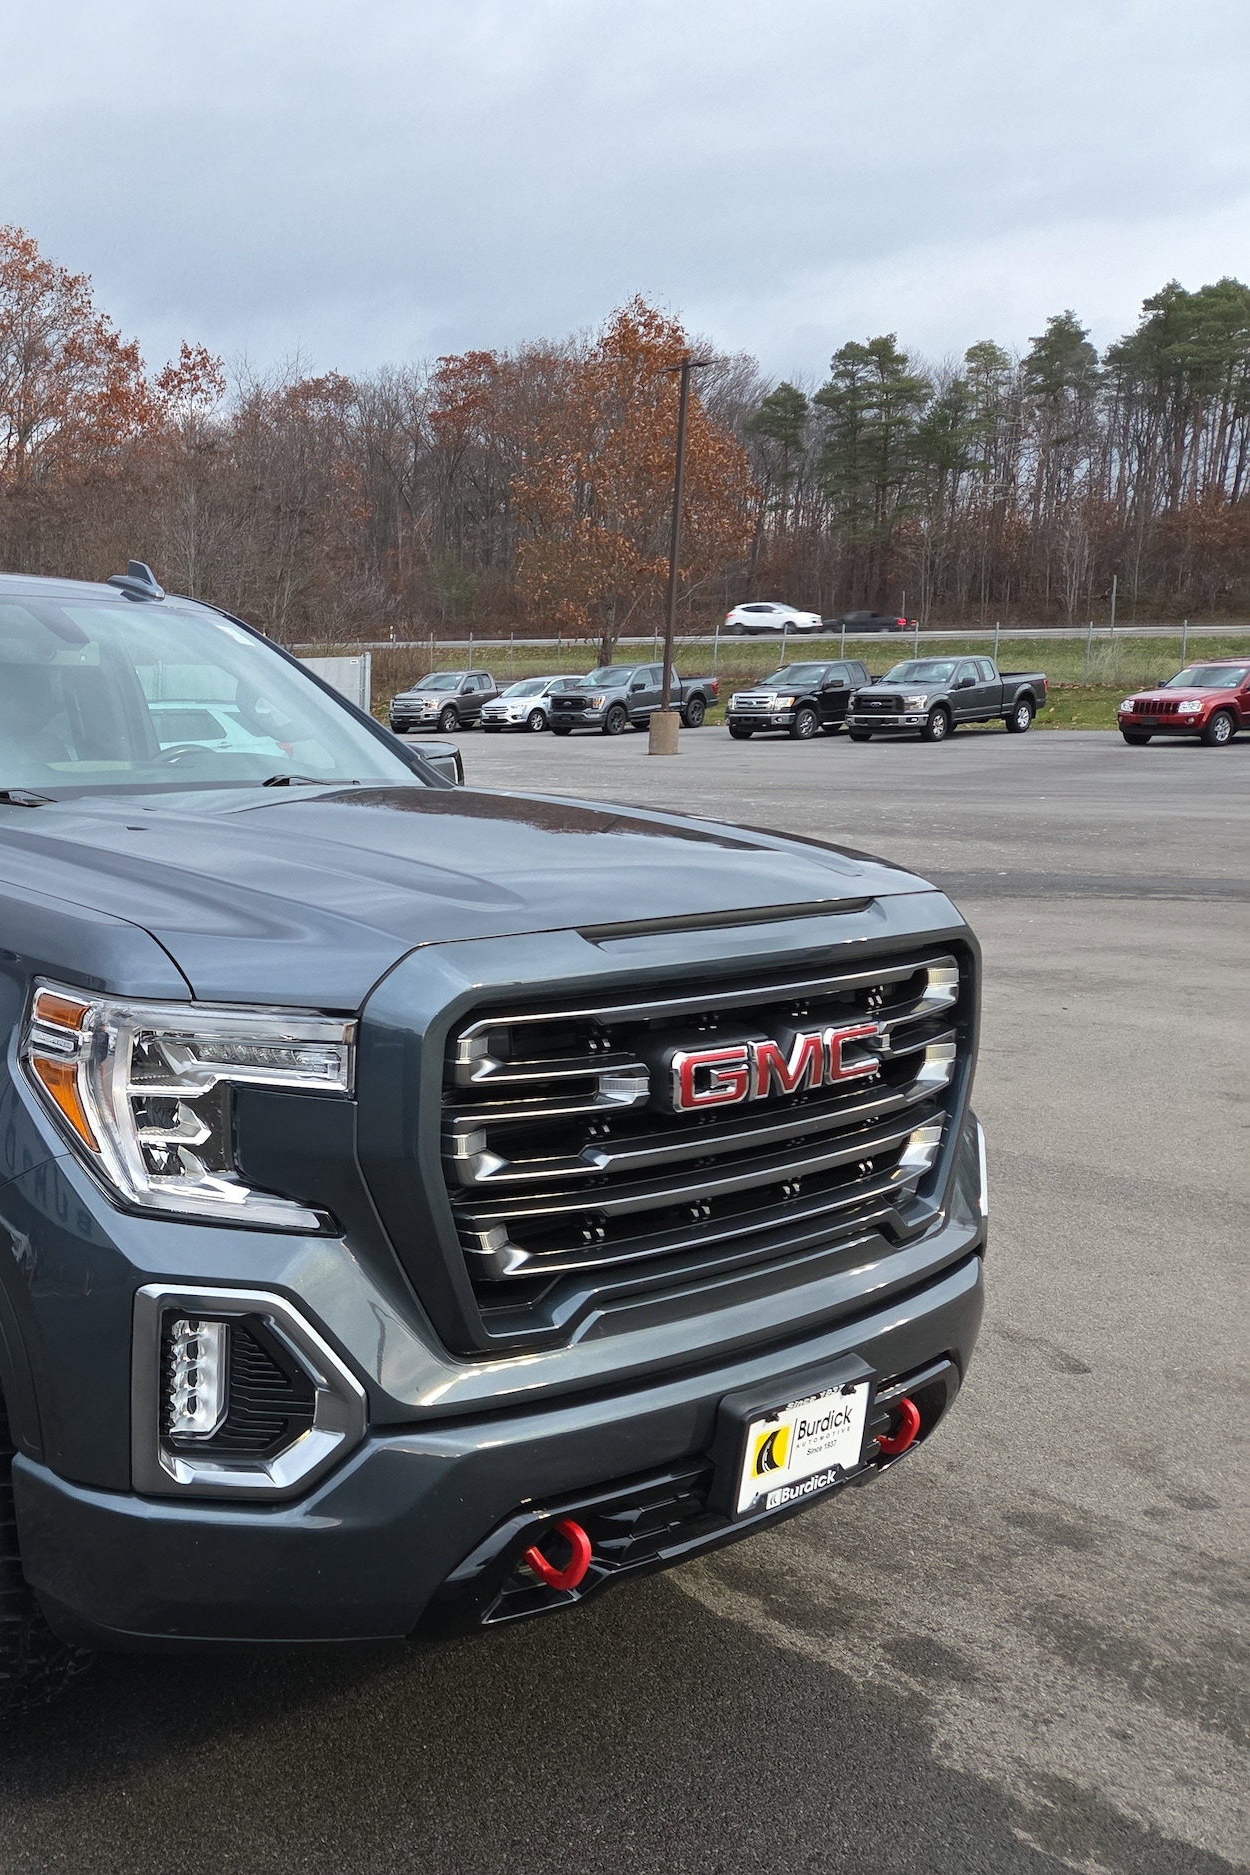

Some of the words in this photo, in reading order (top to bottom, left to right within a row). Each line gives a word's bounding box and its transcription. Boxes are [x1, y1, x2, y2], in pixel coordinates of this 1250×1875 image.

[672, 1021, 880, 1112] GMC
[795, 1426, 851, 1449] AUTOMOTIVE
[798, 1405, 853, 1440] Burdick
[806, 1445, 823, 1456] Since
[824, 1439, 837, 1450] 1937
[781, 1469, 836, 1503] Burdick
